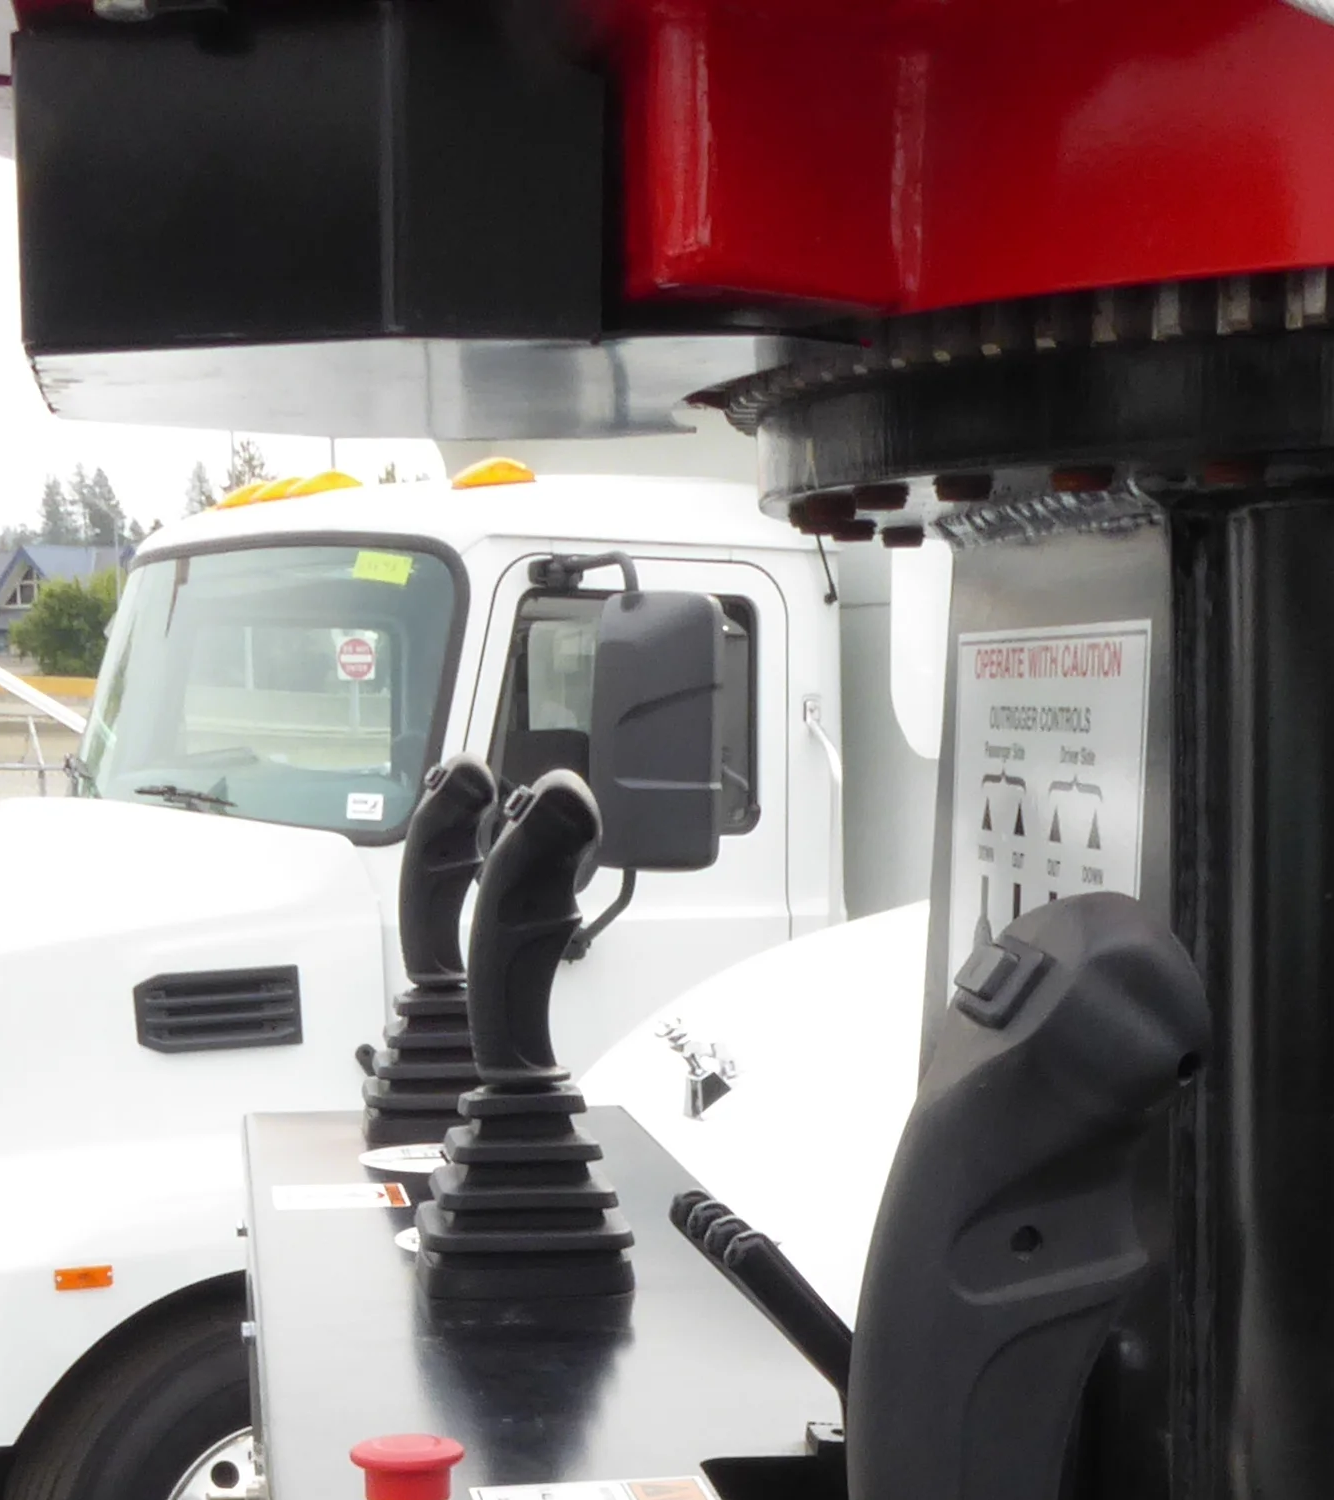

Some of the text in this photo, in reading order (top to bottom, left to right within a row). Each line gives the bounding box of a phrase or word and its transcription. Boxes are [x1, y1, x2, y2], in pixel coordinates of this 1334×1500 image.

[975, 640, 1122, 679] OPERATE WITH CAUTION
